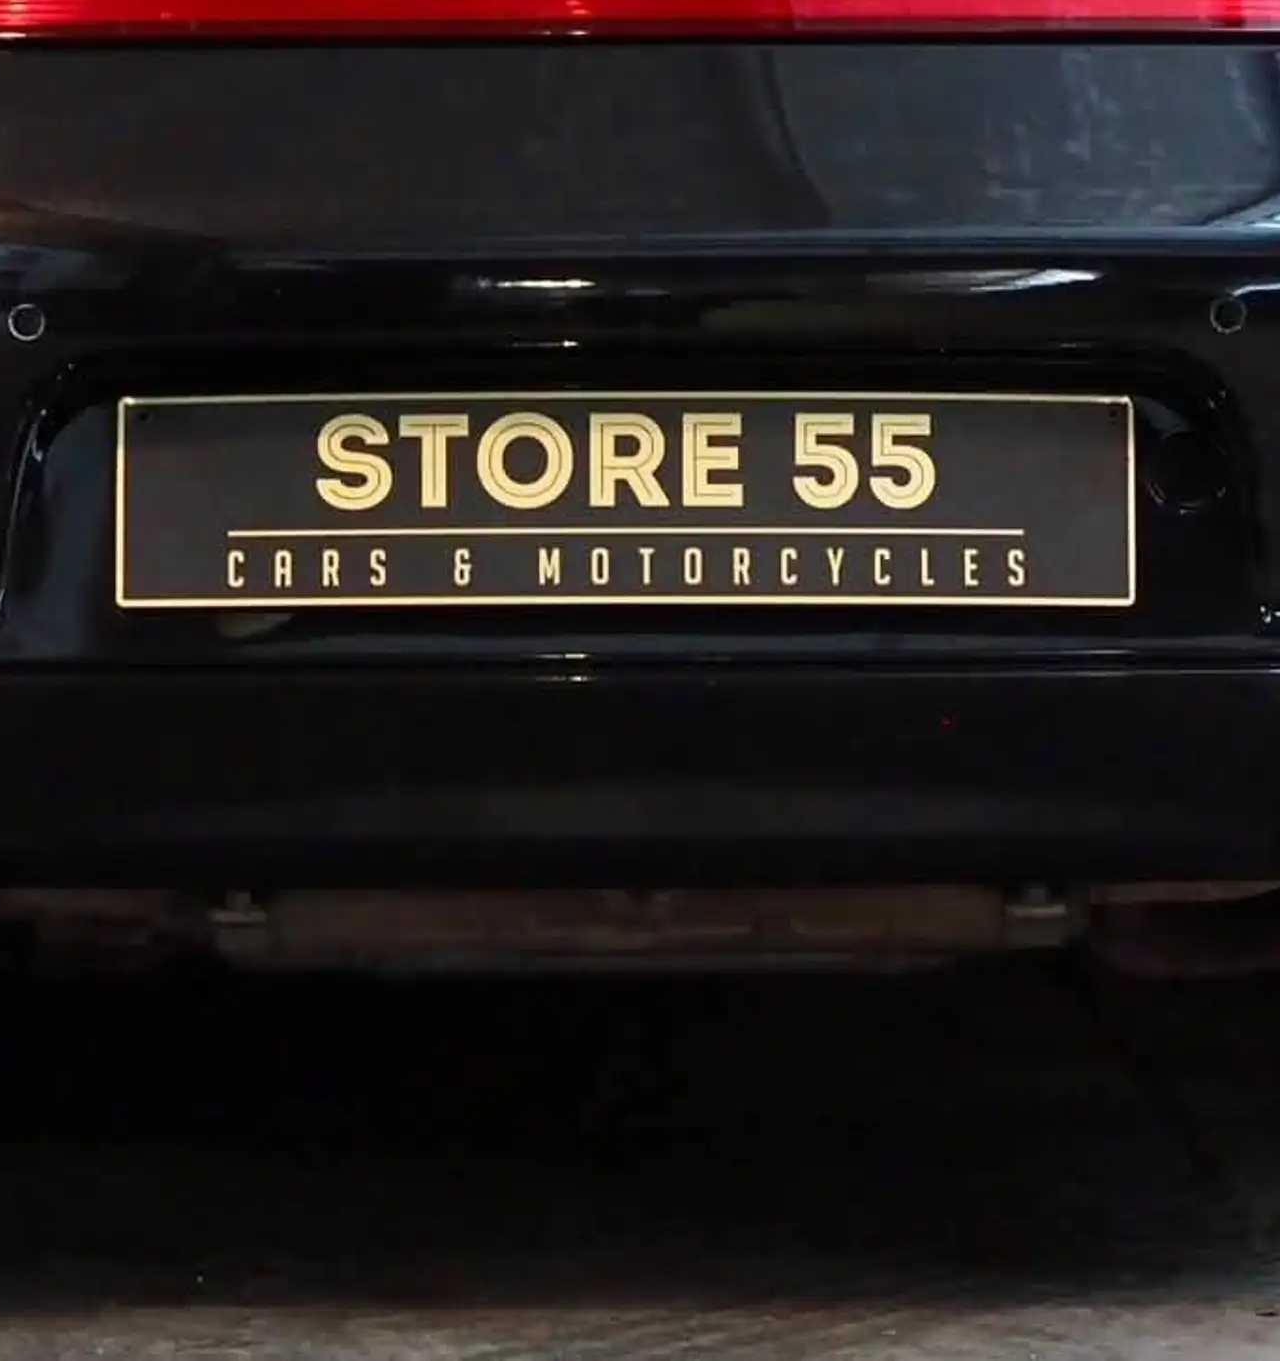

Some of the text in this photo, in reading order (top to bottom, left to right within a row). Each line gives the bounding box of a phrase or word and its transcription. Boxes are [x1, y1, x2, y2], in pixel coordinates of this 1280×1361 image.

[315, 412, 936, 511] STORE 55
[227, 546, 1026, 588] CARS & MOTORCYCLES
